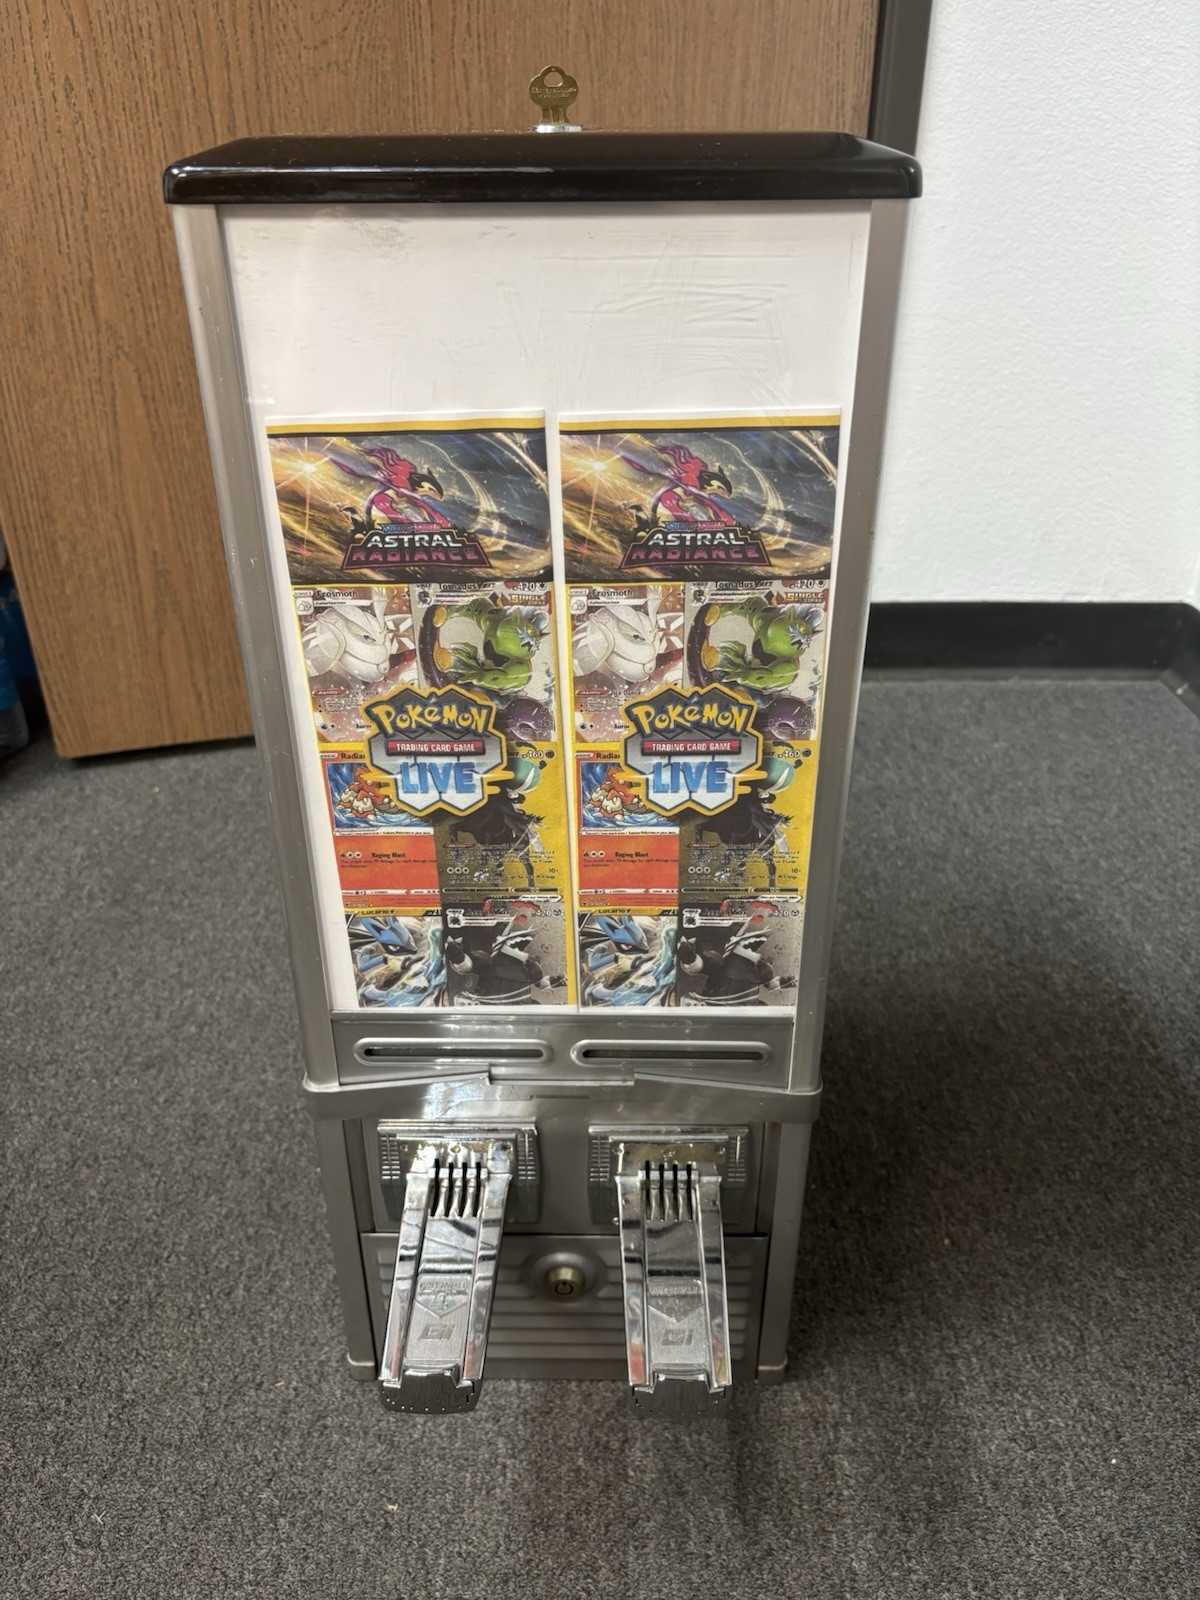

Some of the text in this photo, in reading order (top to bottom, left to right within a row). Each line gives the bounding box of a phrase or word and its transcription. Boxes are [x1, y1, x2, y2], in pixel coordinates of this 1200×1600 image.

[366, 534, 463, 548] ASTRAL
[648, 532, 745, 546] ASTRAL
[351, 548, 479, 562] RADIANCE
[631, 545, 760, 560] RADIANCE
[396, 743, 476, 752] TRADING CARD GAME
[652, 742, 732, 752] TRADING CARD GAME
[401, 762, 477, 794] LIVE
[652, 761, 729, 794] LIVE
[614, 851, 634, 859] Raging
